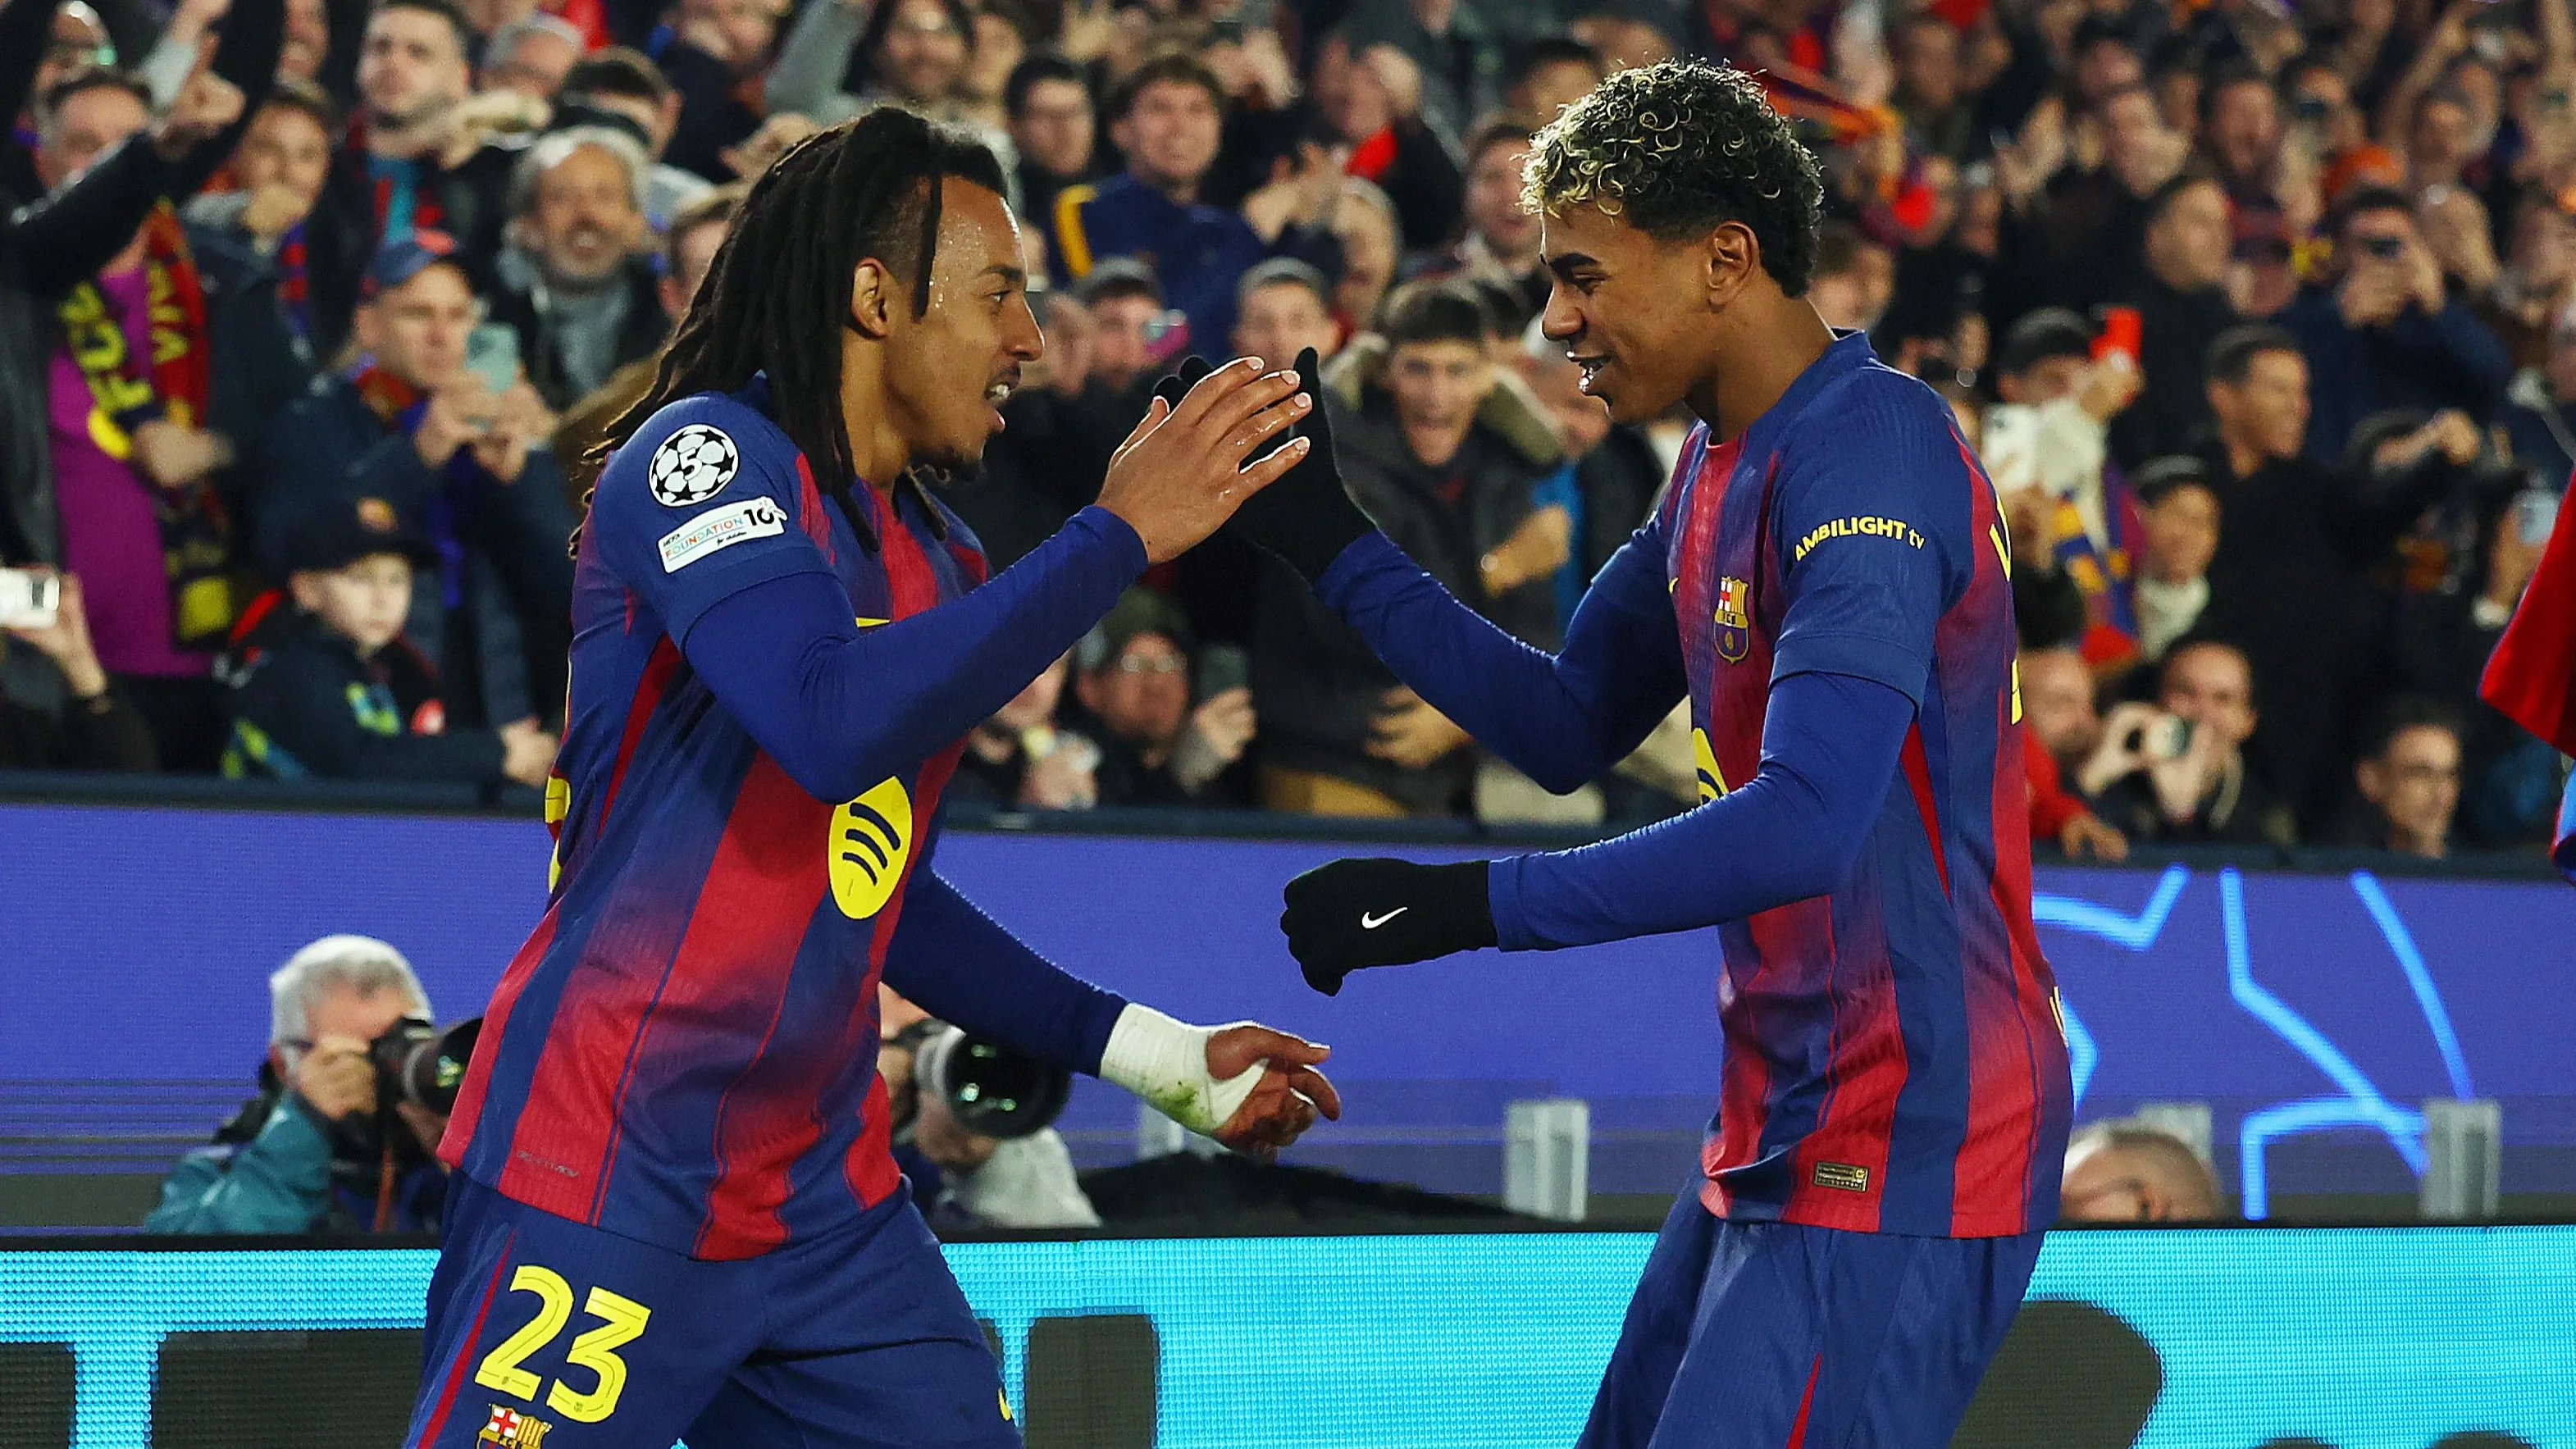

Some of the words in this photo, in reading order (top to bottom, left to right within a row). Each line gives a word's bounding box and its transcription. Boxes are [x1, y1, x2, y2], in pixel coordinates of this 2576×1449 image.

[680, 447, 703, 481] 5
[665, 517, 744, 558] FOUNDATION
[1795, 516, 1907, 562] AMBILIGHT
[1908, 528, 1926, 550] tv
[474, 1264, 653, 1424] 23
